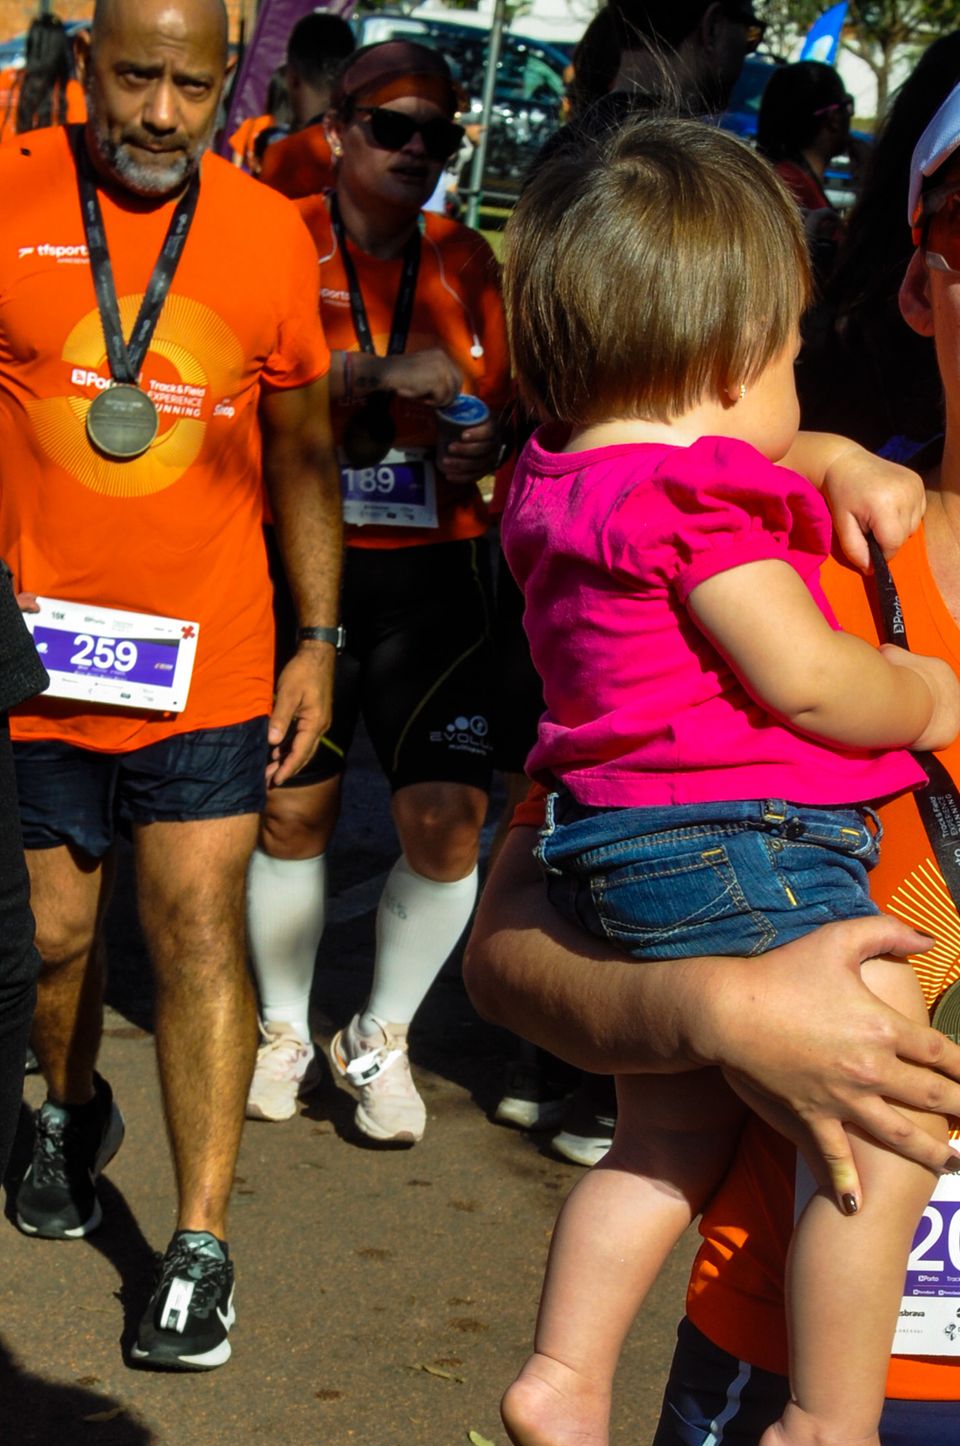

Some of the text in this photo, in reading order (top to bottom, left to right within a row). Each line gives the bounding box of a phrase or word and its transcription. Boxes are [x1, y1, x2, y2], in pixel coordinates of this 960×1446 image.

[37, 244, 88, 257] tfsport
[86, 372, 112, 390] Por
[155, 404, 201, 417] UNNING
[341, 466, 396, 494] 189
[70, 633, 138, 673] 259
